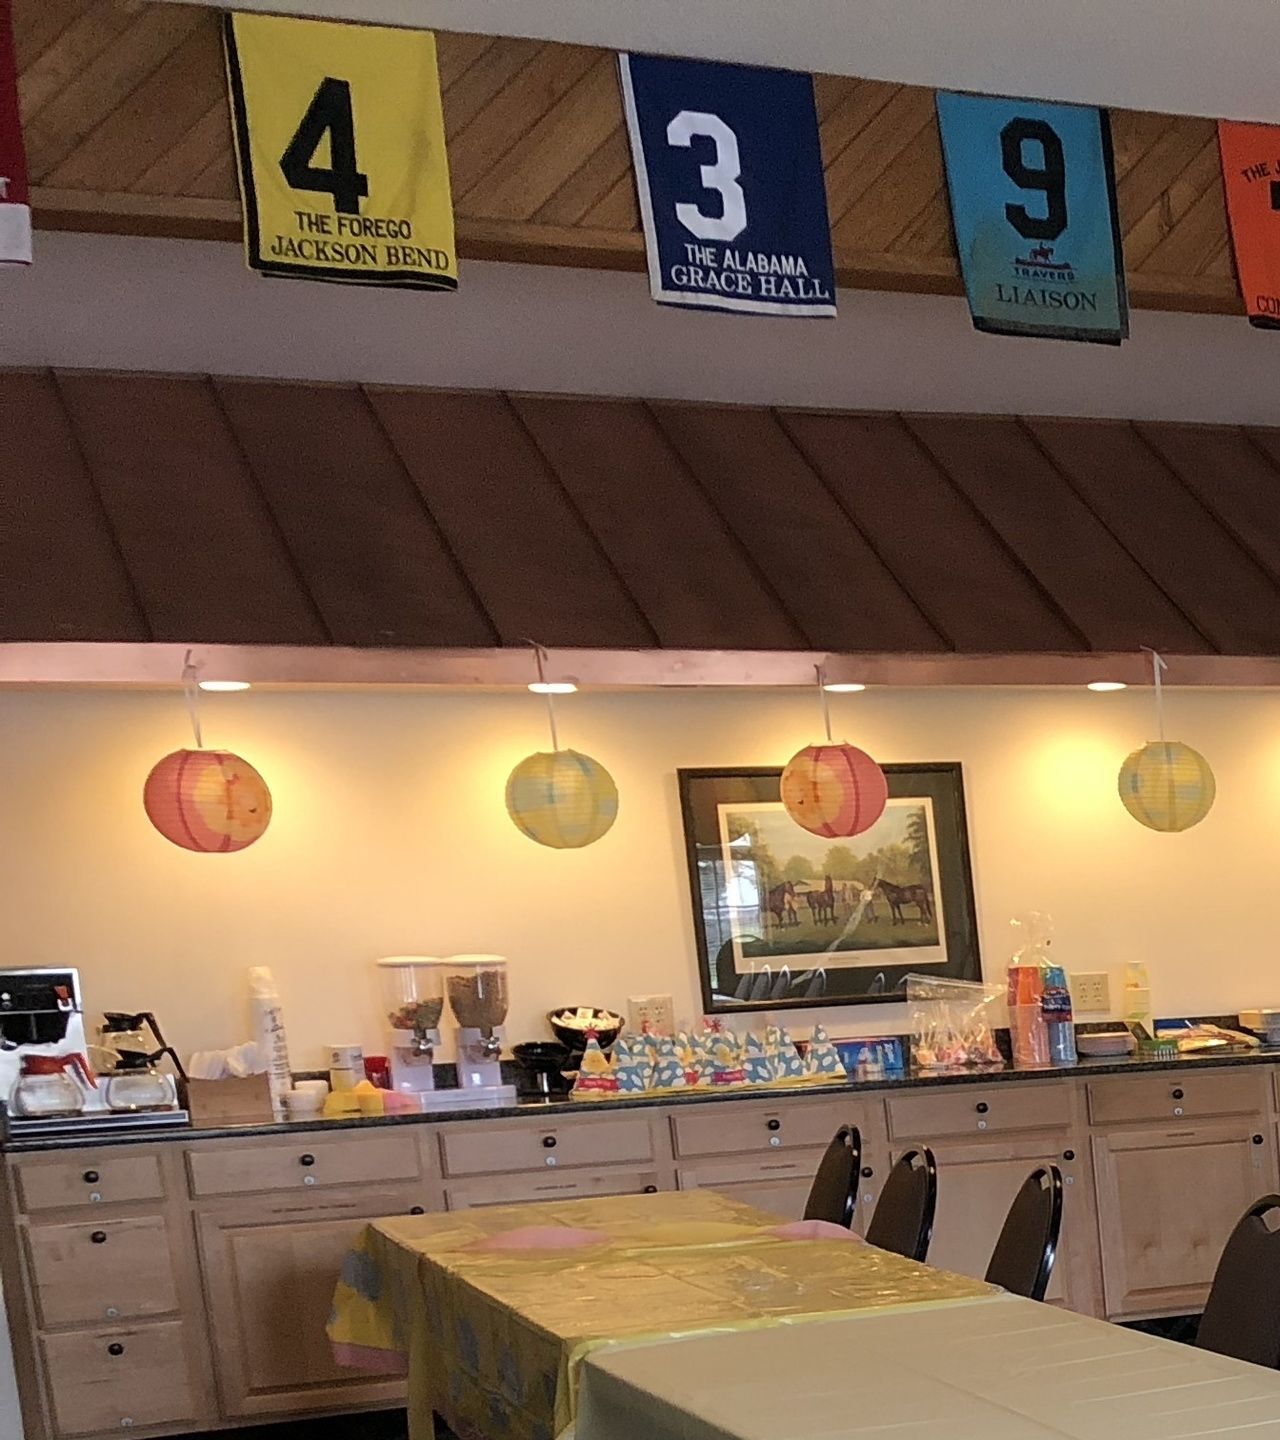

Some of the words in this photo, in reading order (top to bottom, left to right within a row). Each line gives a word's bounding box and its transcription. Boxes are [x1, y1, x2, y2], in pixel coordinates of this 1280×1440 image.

[279, 76, 368, 215] 4
[667, 110, 747, 242] 3
[1001, 117, 1067, 240] 9
[1242, 162, 1271, 183] THE
[294, 211, 332, 235] THE
[337, 216, 411, 239] FOREGO
[271, 235, 378, 265] JACKSON
[386, 245, 449, 270] BEND
[685, 243, 717, 267] THE
[723, 248, 808, 277] ALABAMA
[671, 265, 751, 294] GRACE
[759, 276, 830, 299] HALL
[1014, 267, 1075, 280] TRAVERS
[996, 283, 1097, 312] LIAISON
